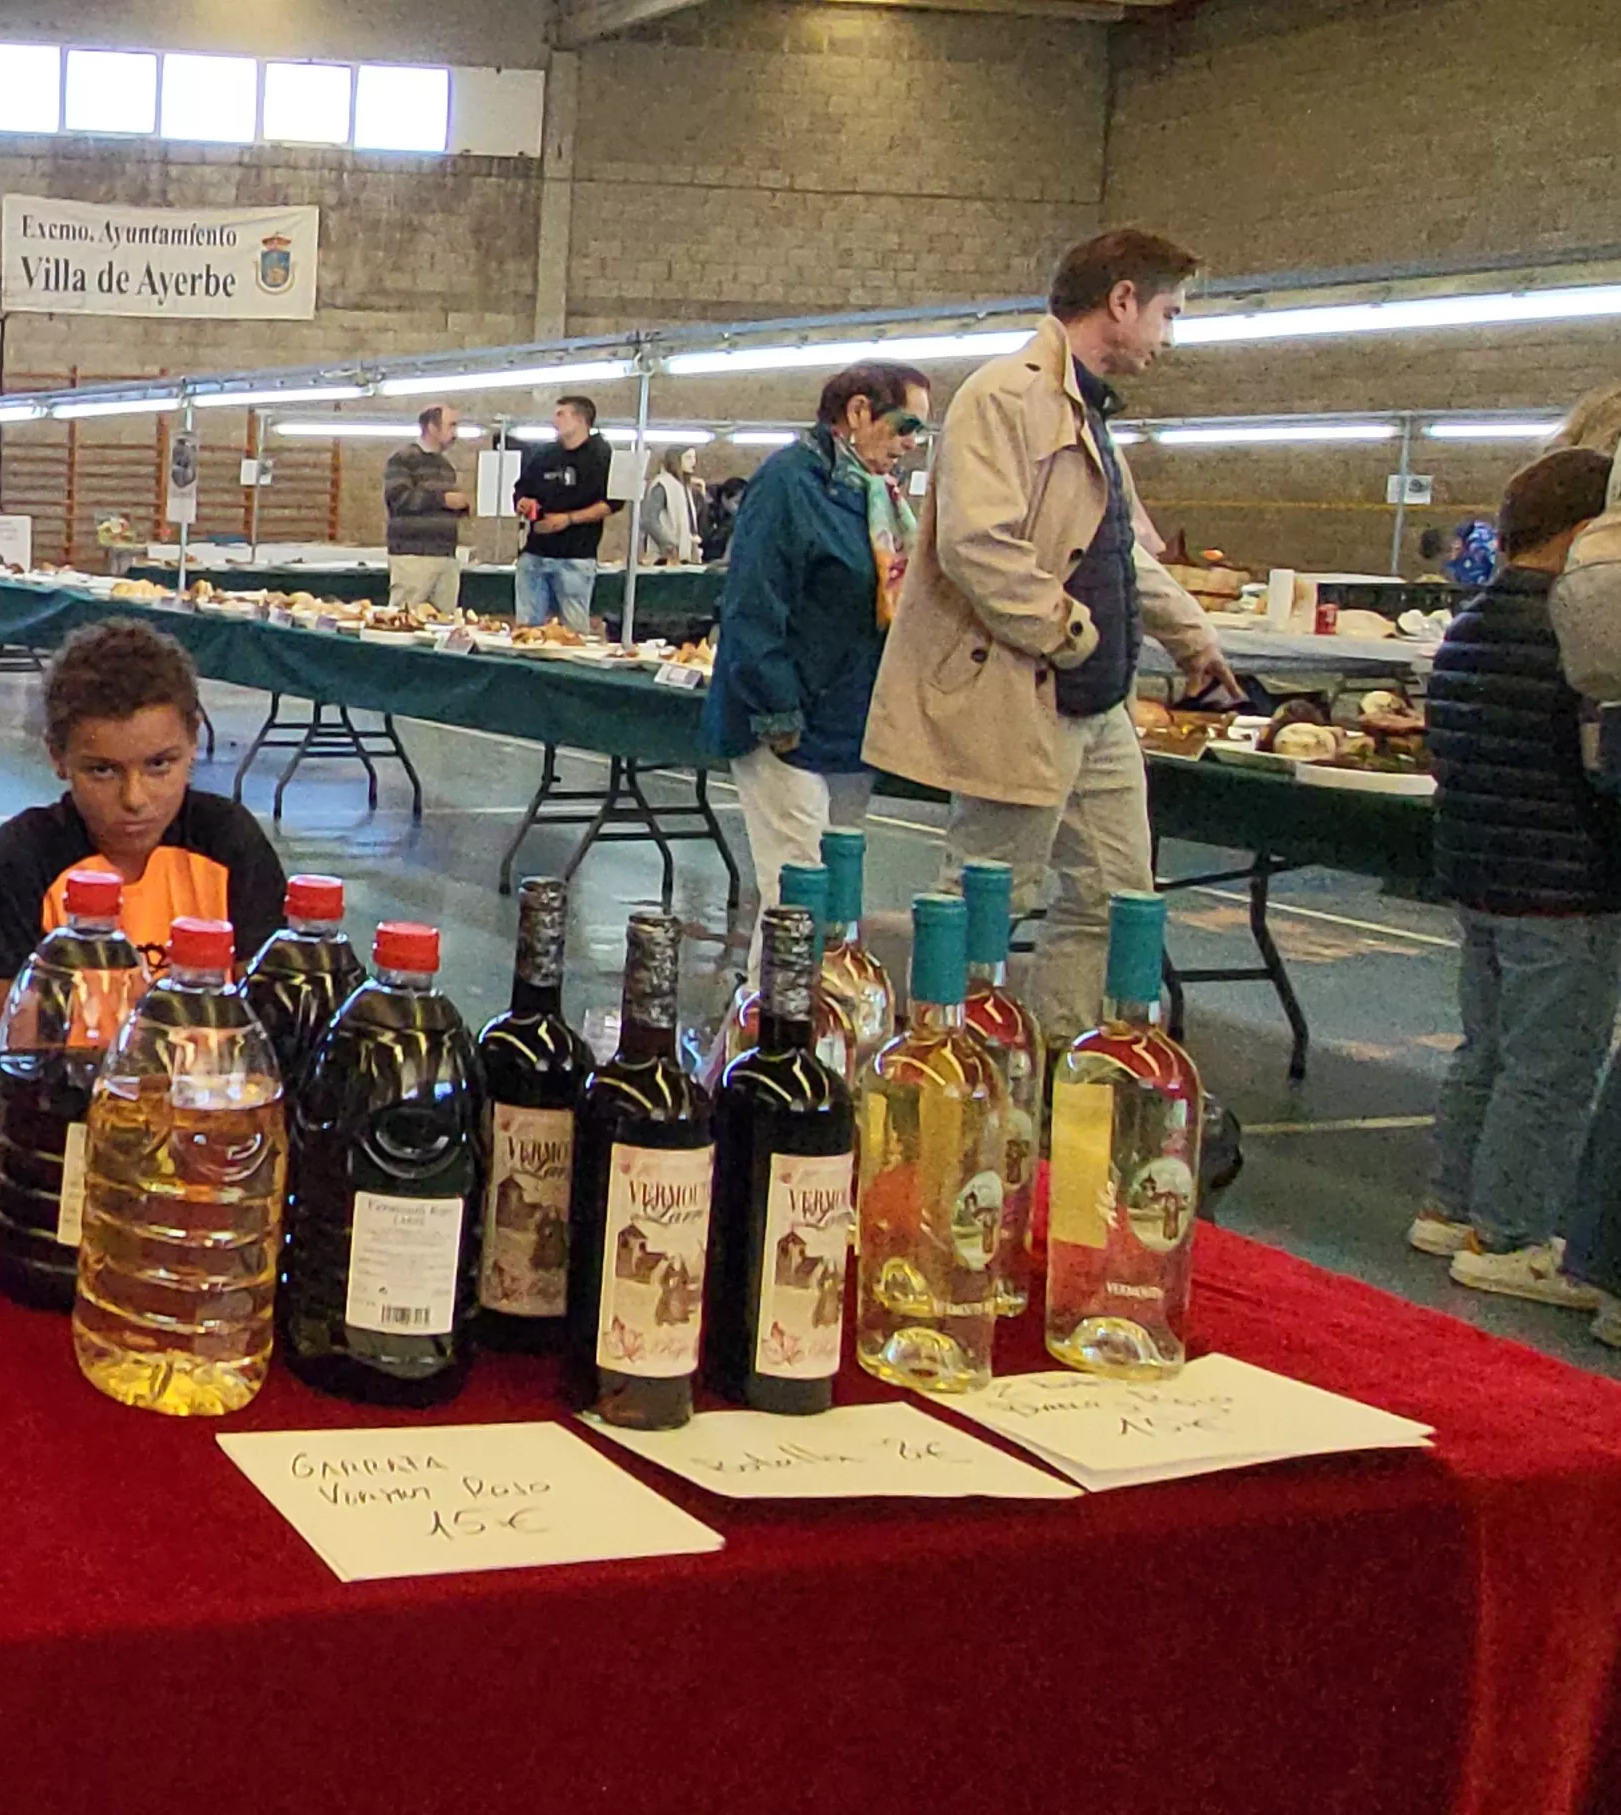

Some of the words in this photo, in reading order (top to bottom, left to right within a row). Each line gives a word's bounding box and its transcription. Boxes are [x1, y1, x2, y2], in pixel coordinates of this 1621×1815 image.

[99, 220, 238, 250] Ayuntamiento
[21, 256, 87, 293] Villa
[97, 261, 130, 295] de
[136, 262, 237, 306] Ayerbe
